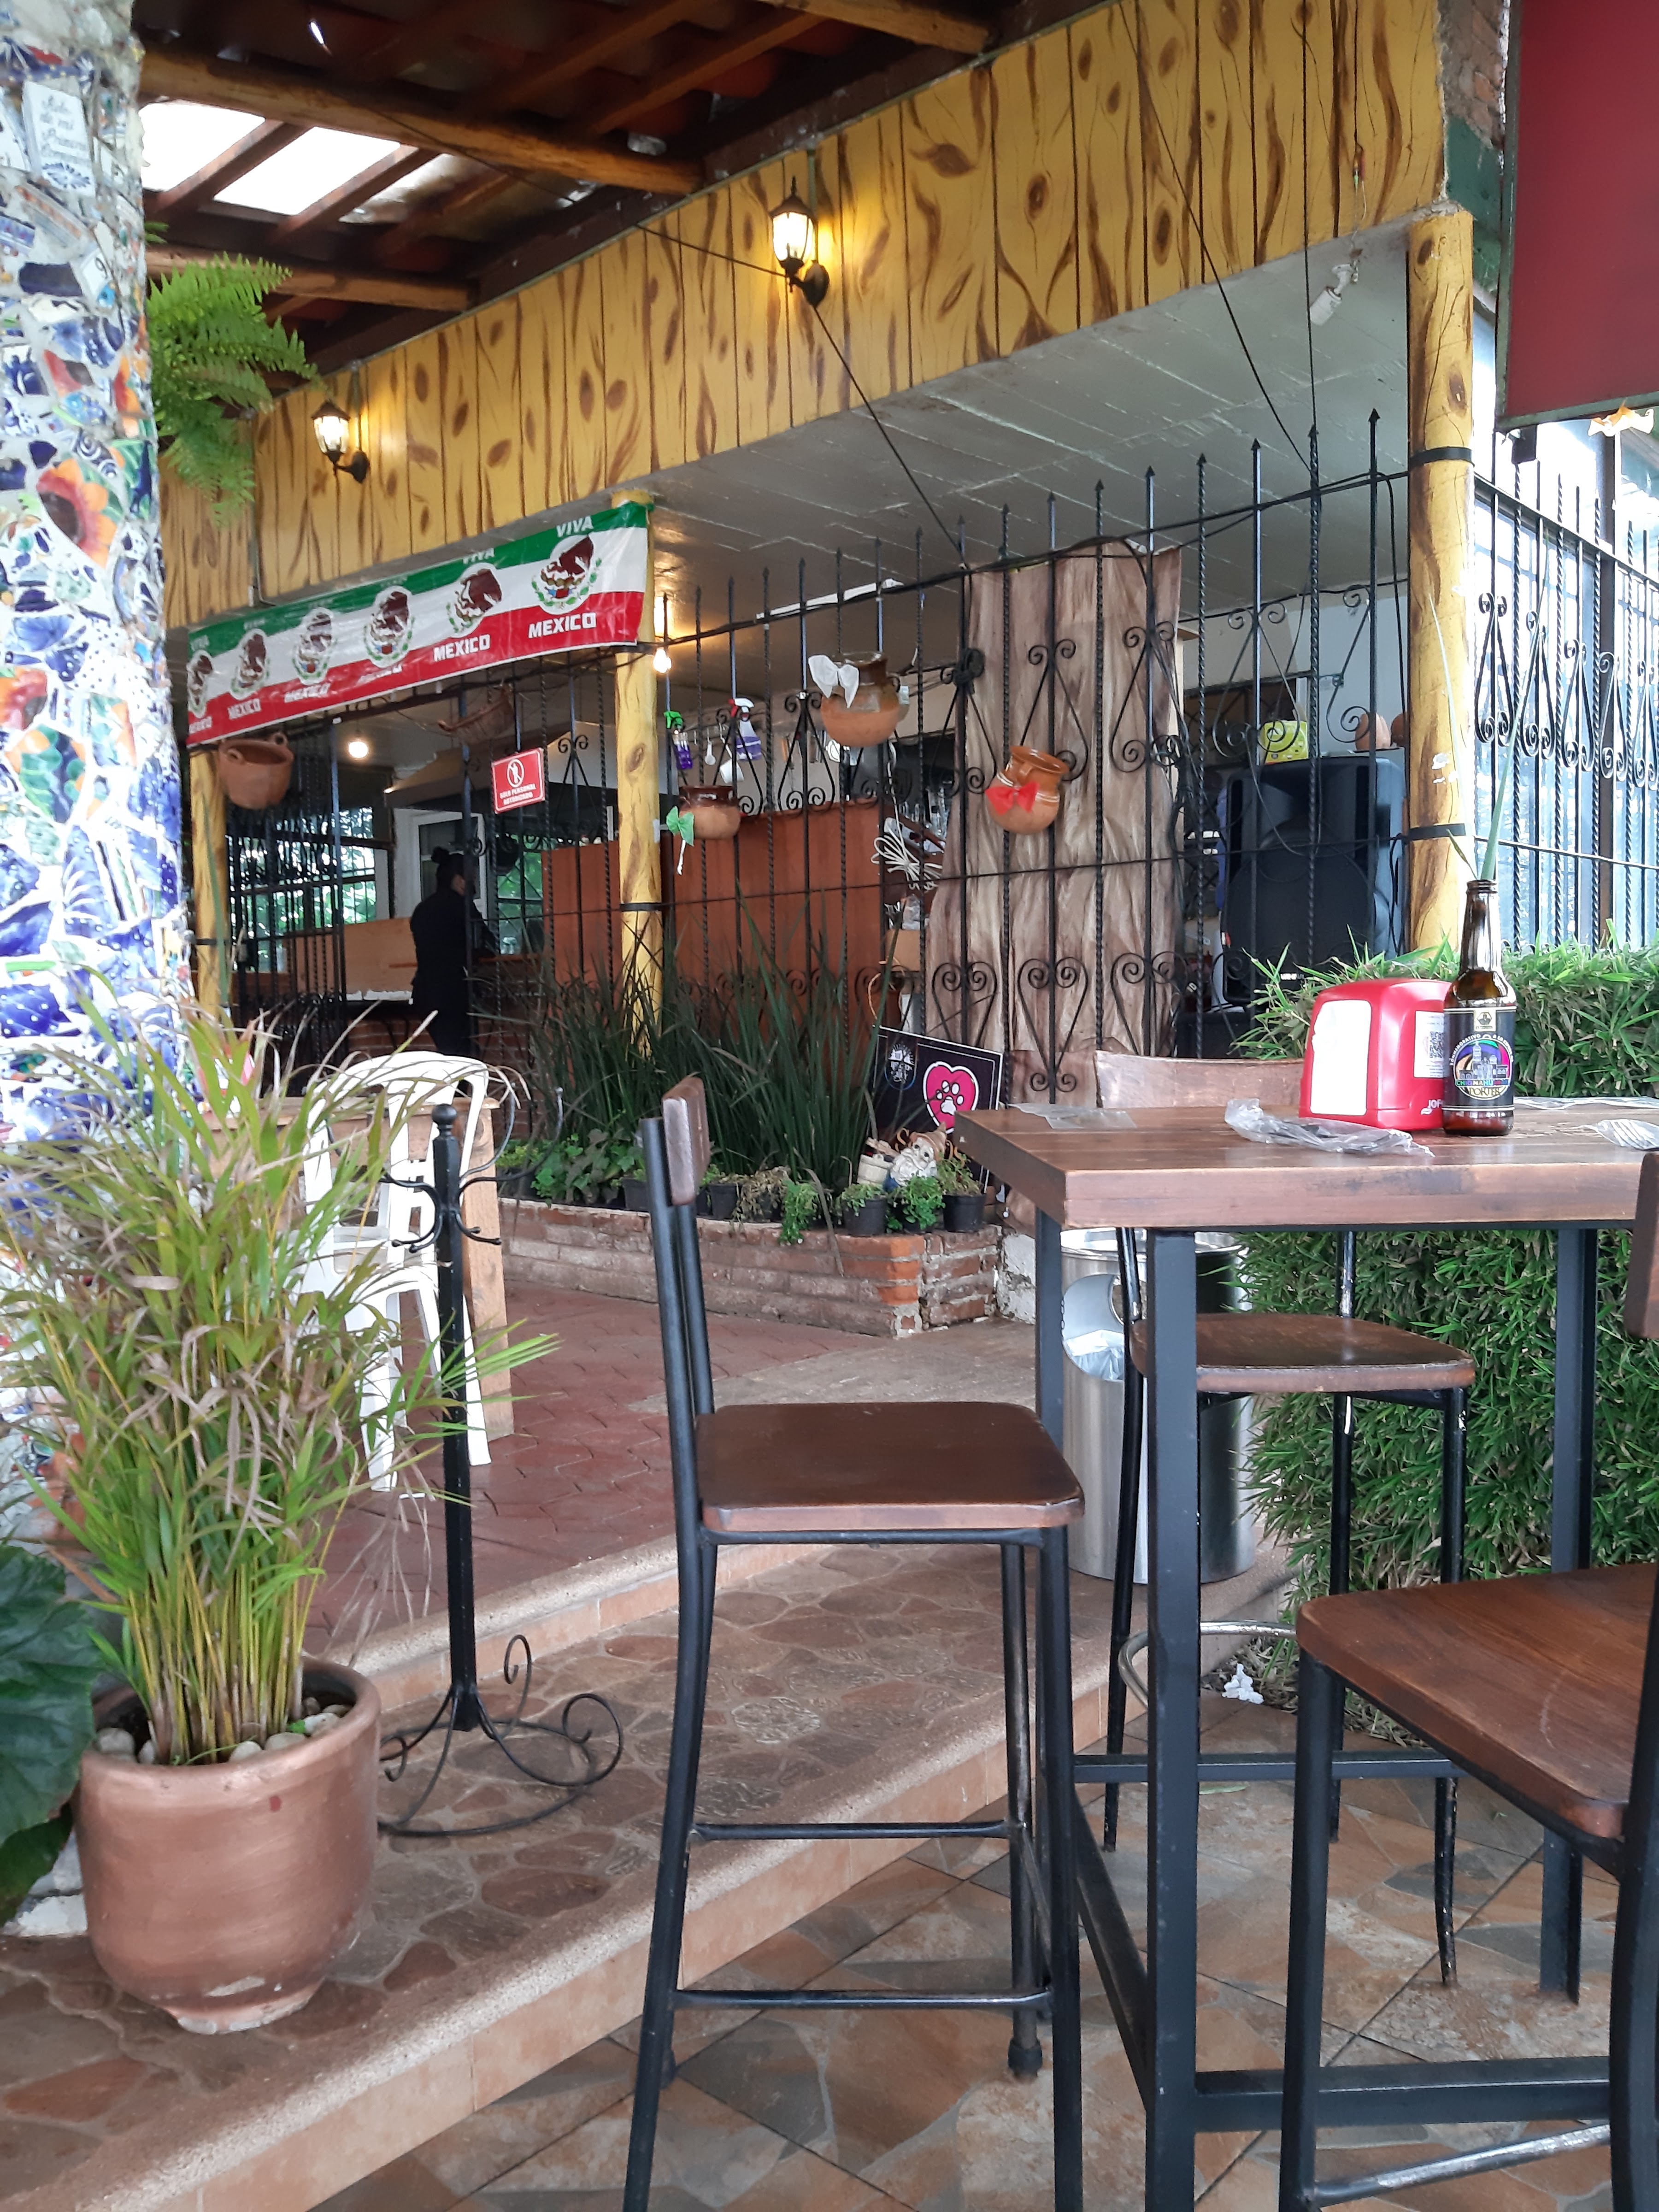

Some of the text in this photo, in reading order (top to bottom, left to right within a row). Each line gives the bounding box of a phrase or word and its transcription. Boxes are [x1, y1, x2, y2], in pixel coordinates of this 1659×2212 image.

[556, 516, 594, 537] VIVA
[528, 612, 597, 638] MEXICO
[433, 634, 491, 662] MEXICO
[227, 698, 261, 720] MEXICO
[1469, 1088, 1500, 1096] PORTER
